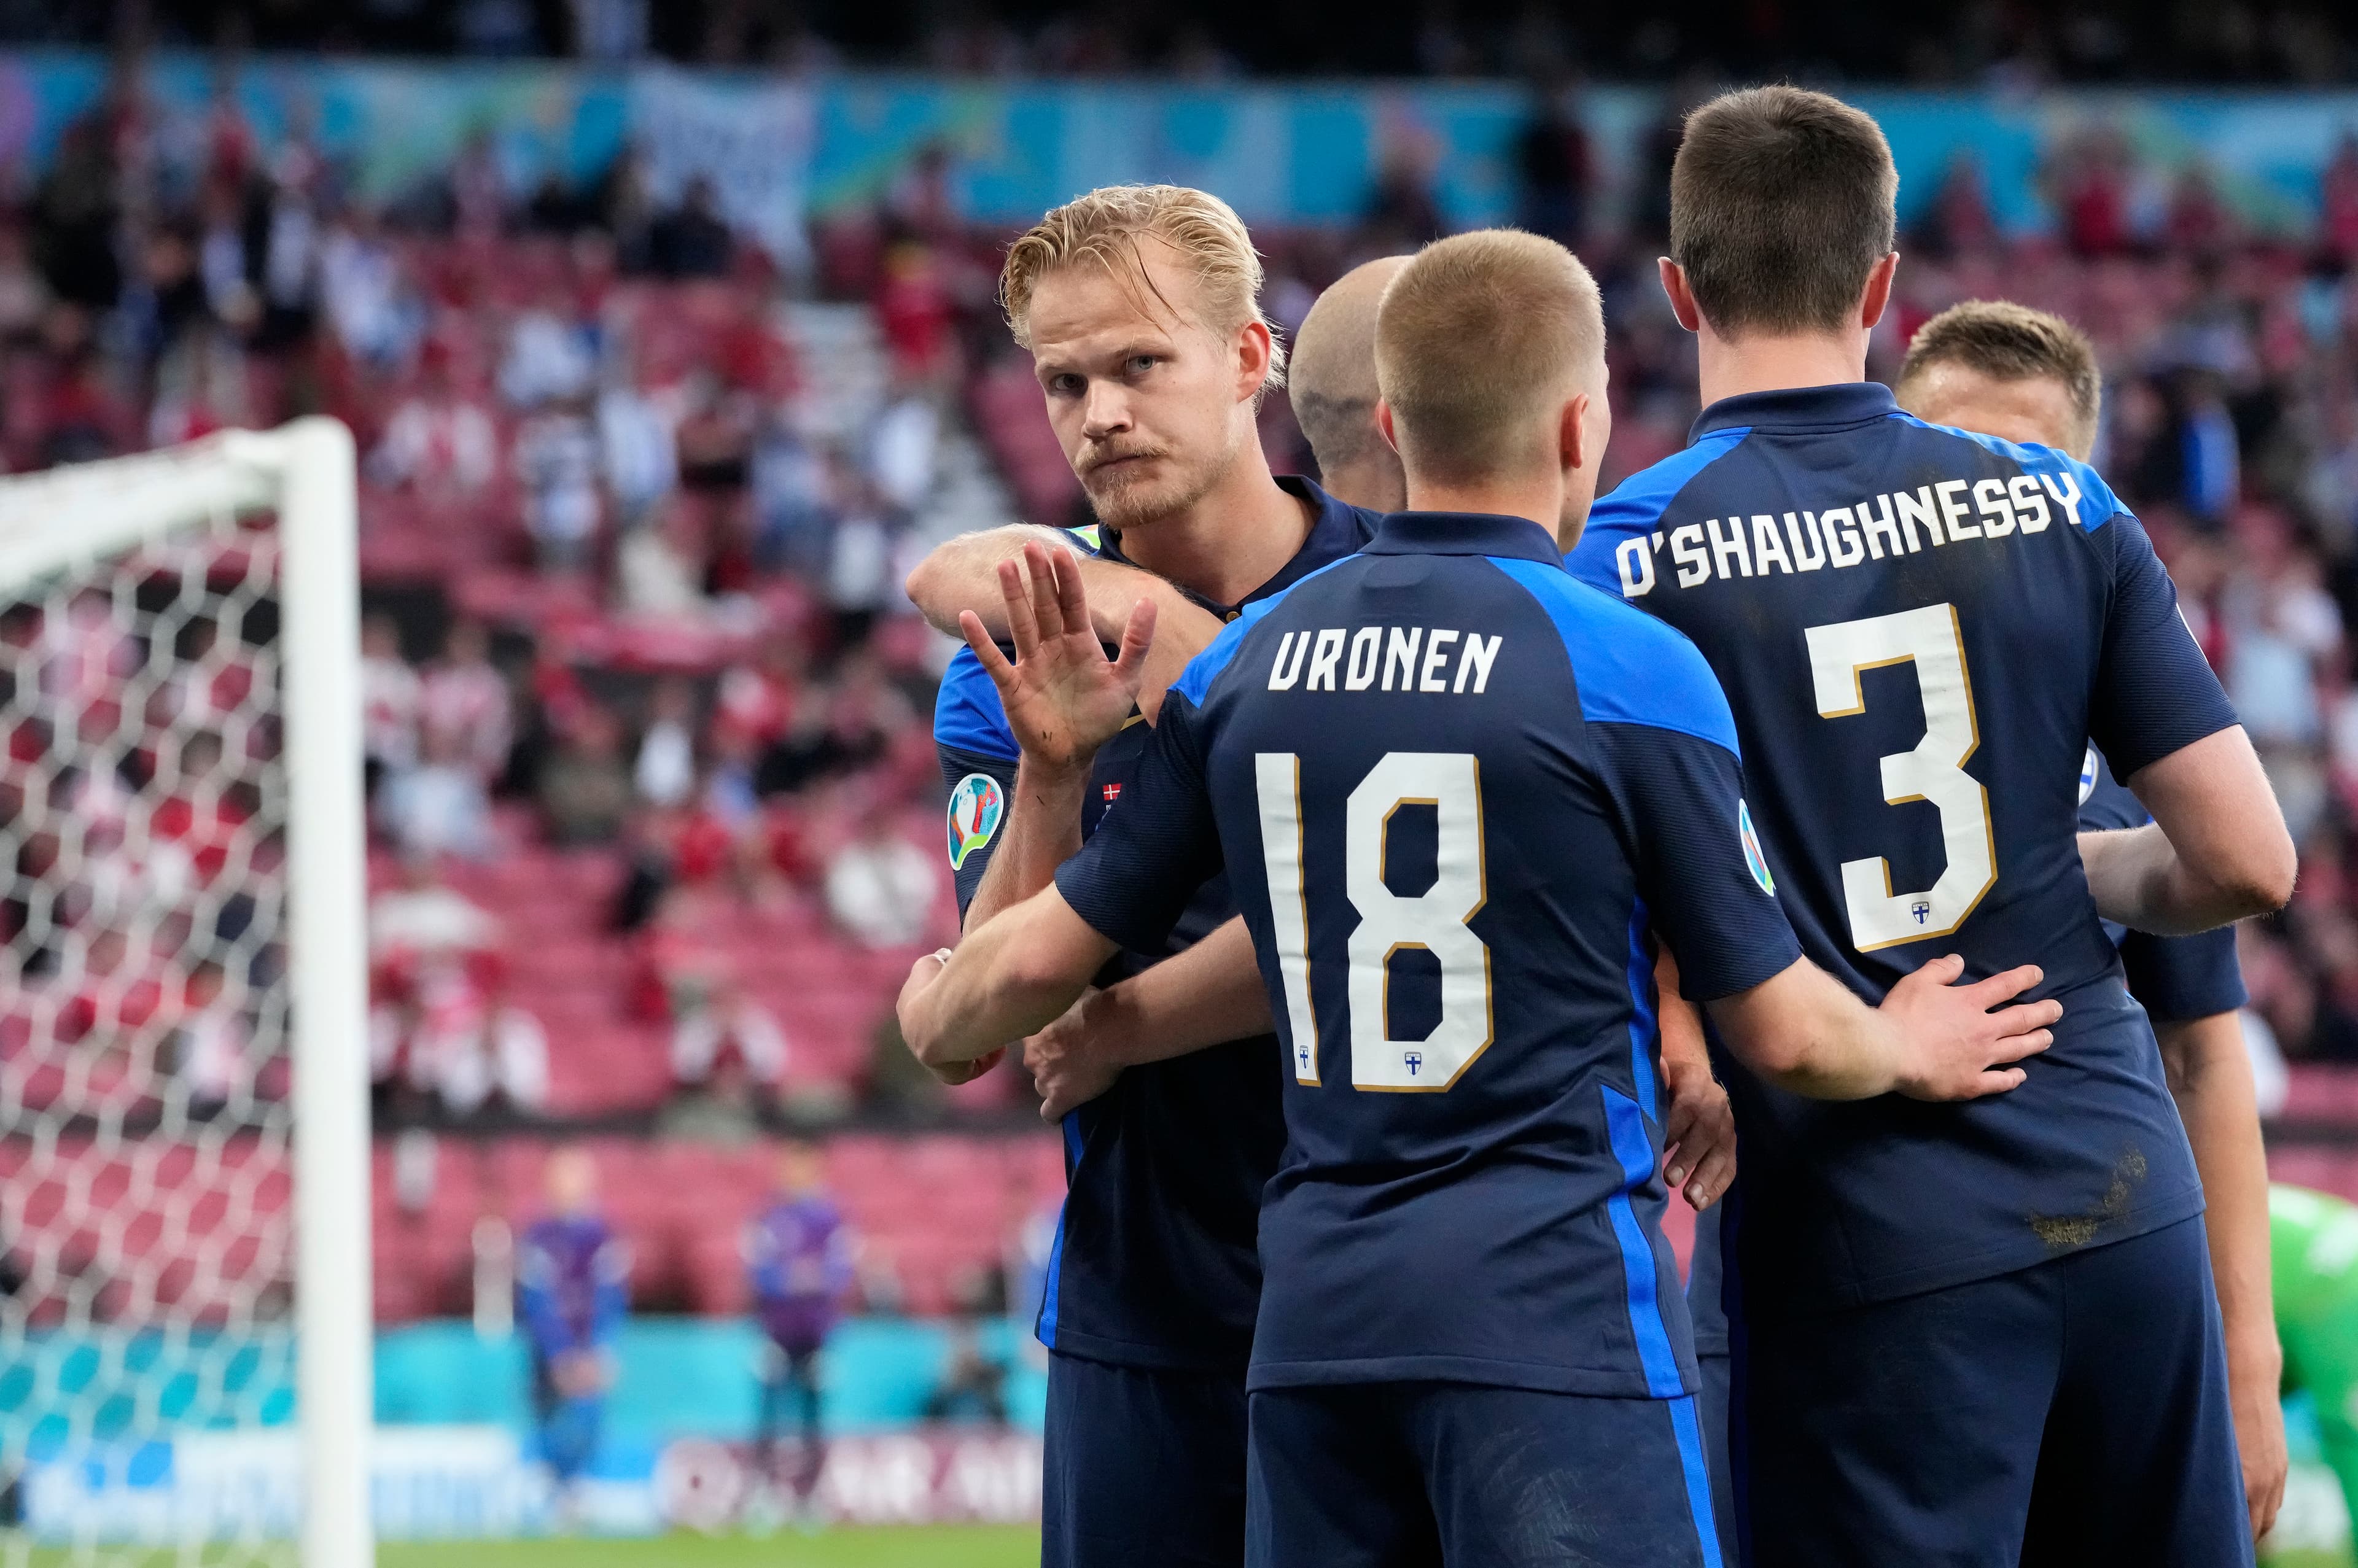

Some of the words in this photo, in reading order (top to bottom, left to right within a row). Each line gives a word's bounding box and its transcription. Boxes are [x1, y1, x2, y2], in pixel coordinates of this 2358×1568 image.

[1615, 470, 2083, 598] O'SHAUGHNESSY
[1267, 626, 1503, 694] URONEN
[1804, 602, 1998, 953] 3
[1255, 751, 1495, 1092] 18
